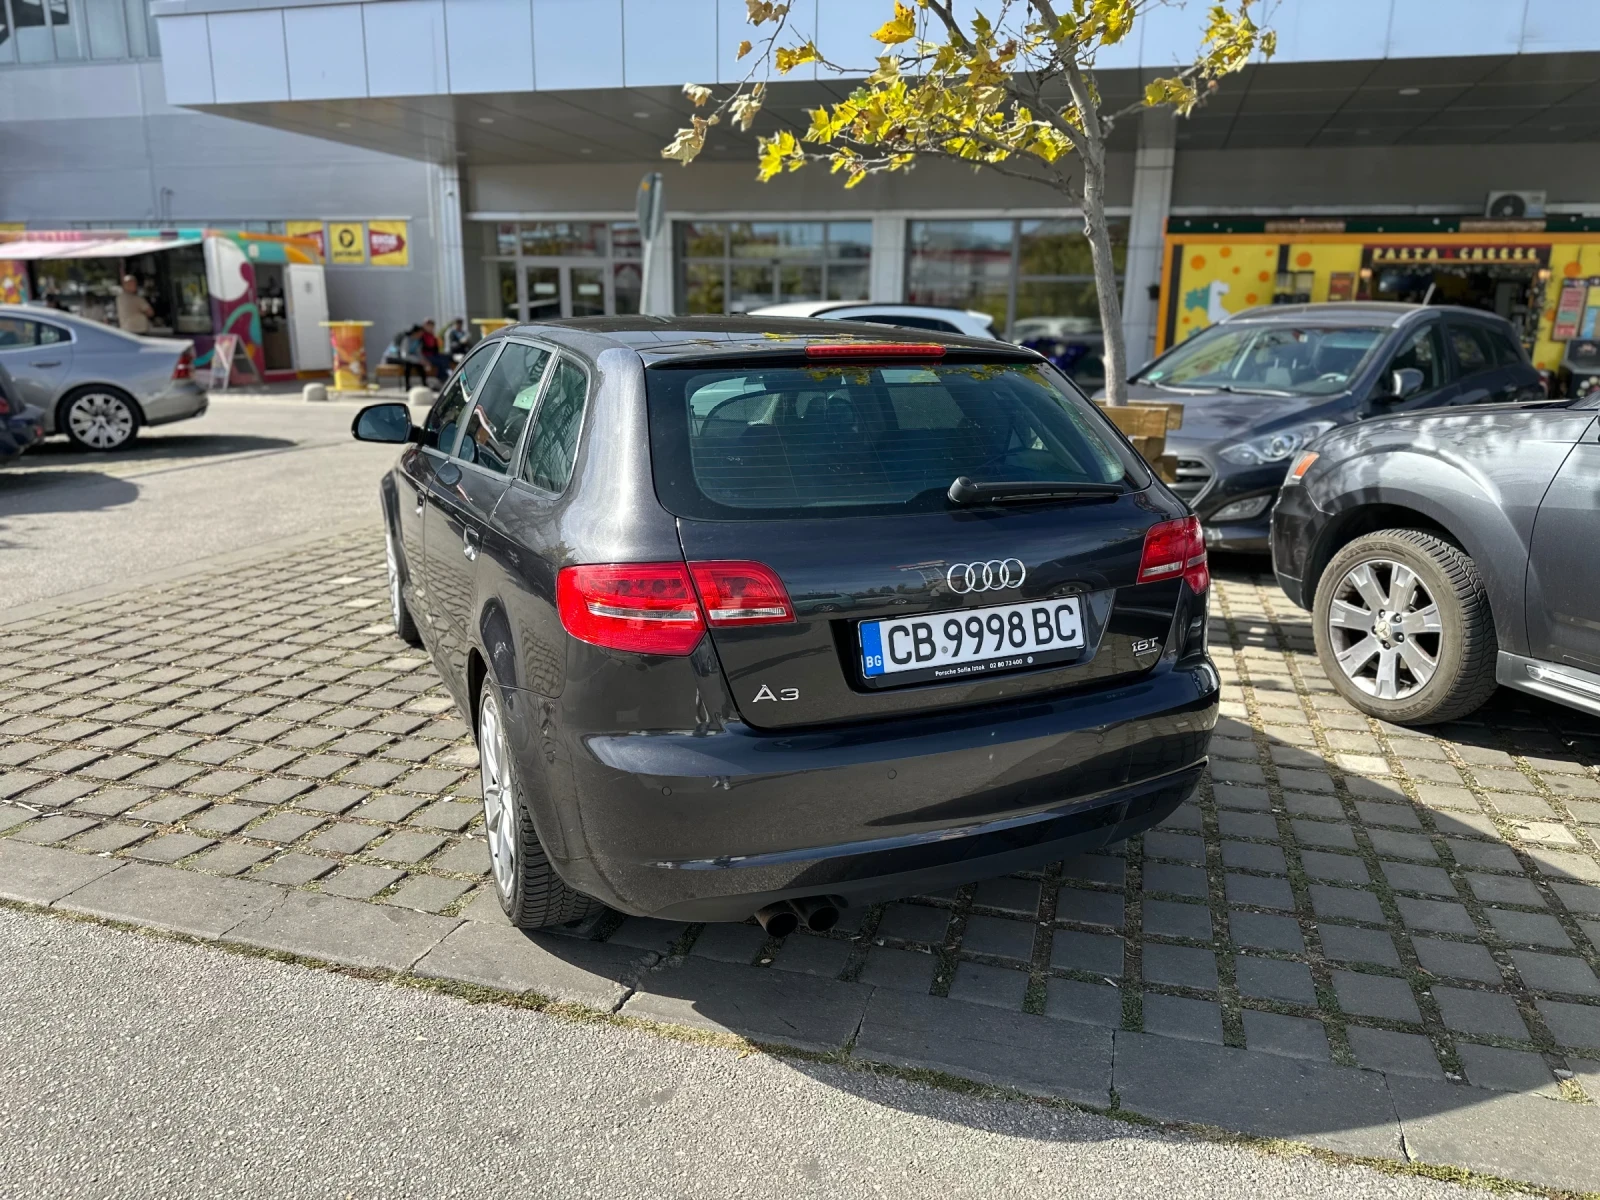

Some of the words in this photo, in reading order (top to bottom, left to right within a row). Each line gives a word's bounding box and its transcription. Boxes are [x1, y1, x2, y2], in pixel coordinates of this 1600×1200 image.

[1372, 247, 1438, 260] PASTA
[1459, 247, 1537, 260] CHEESE
[943, 611, 1026, 658] 9998
[866, 655, 882, 668] BG
[935, 669, 957, 677] Porsche
[957, 665, 971, 674] Sofia
[752, 684, 800, 702] A3
